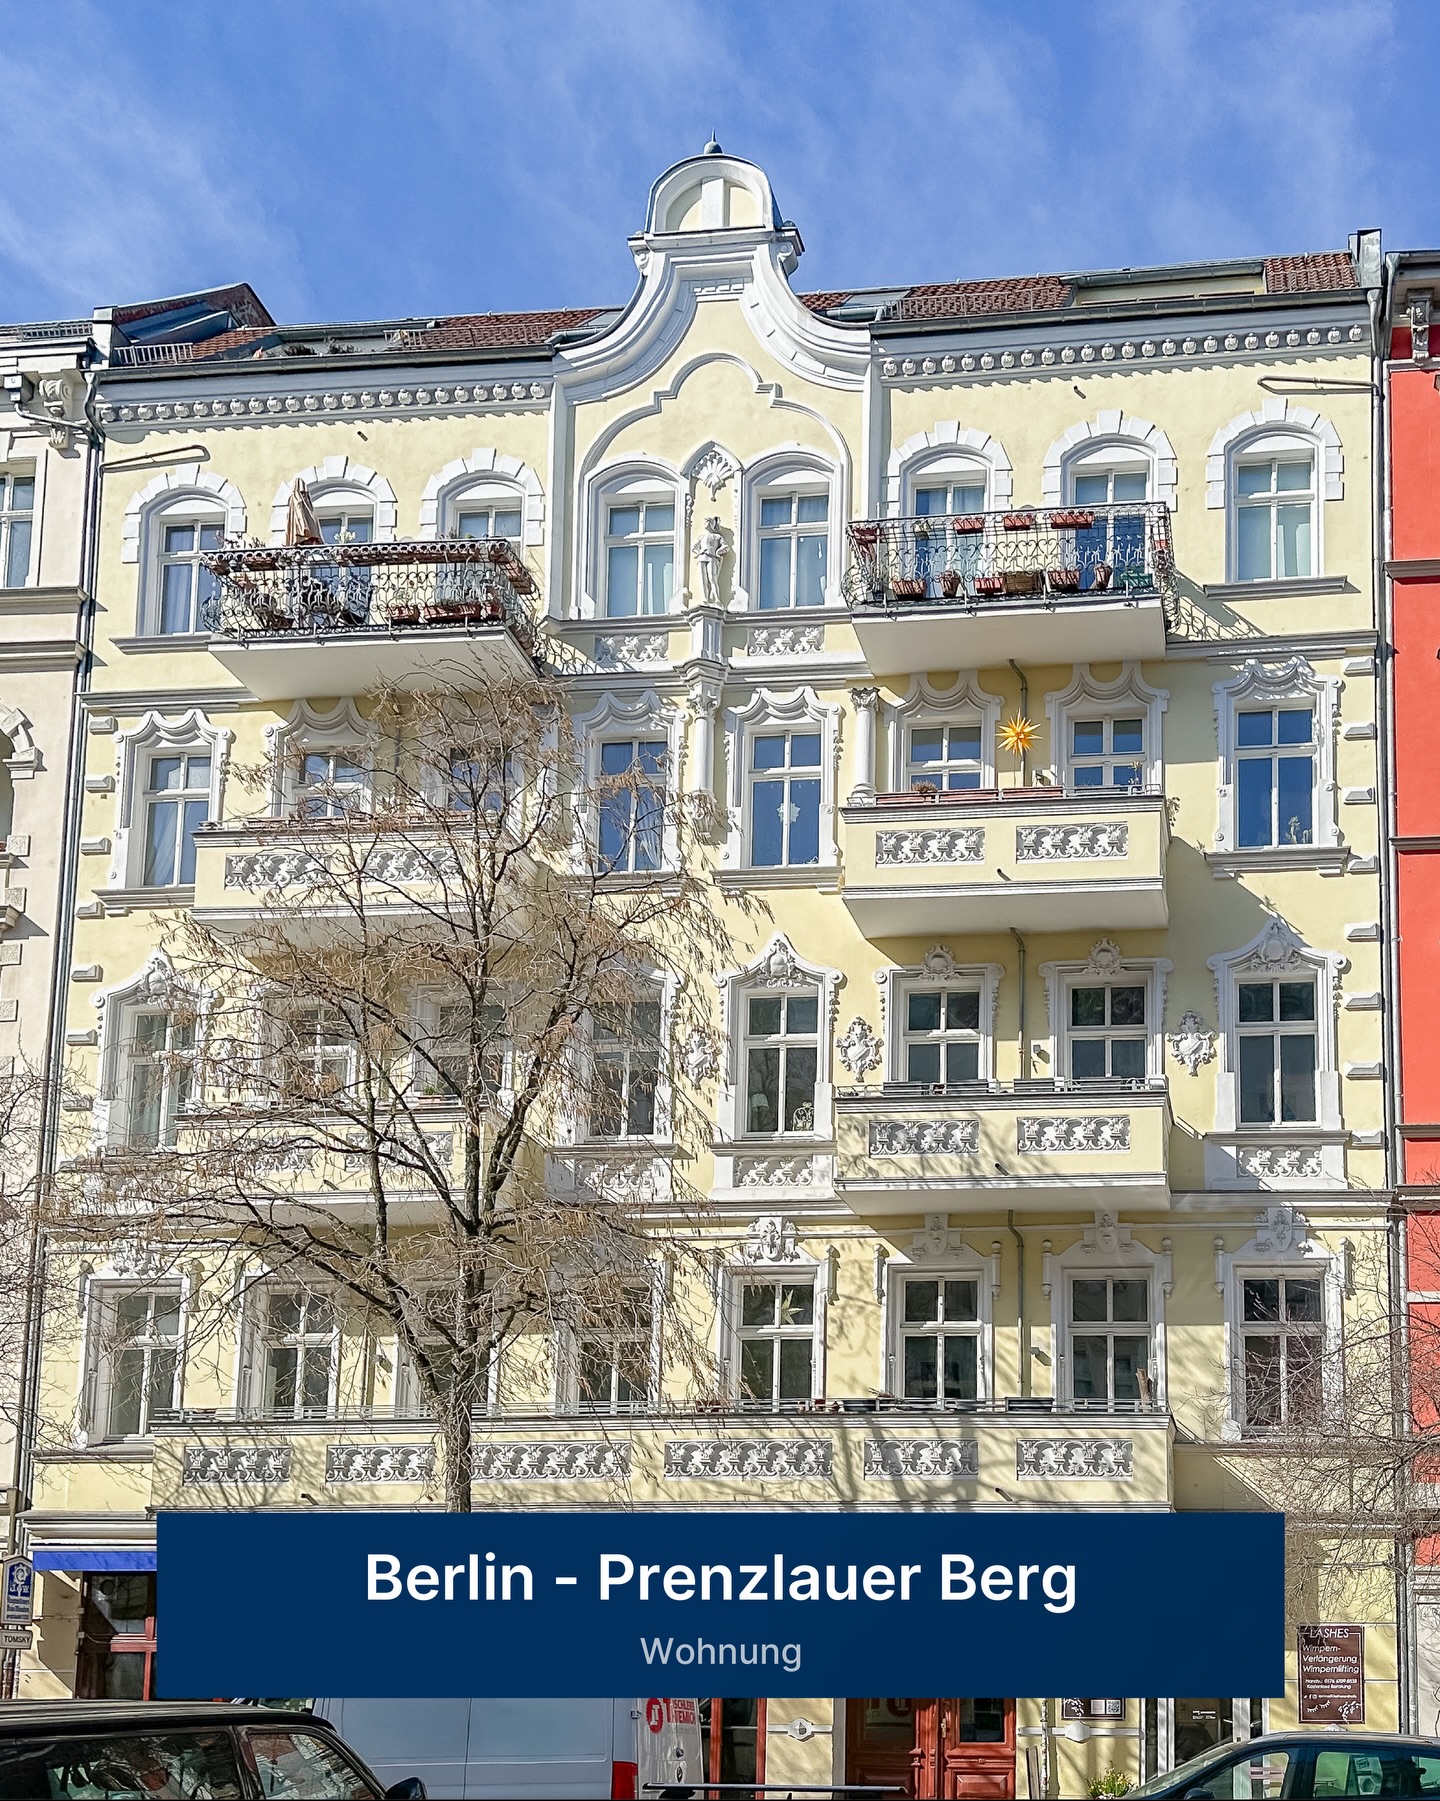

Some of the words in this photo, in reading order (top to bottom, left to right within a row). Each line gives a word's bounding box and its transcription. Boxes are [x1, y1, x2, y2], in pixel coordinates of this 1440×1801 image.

[1310, 1628, 1350, 1638] LASHES
[4, 1635, 31, 1643] TOMSKY
[1303, 1654, 1357, 1663] Verlängerung
[1303, 1664, 1360, 1674] Wimpernlifting
